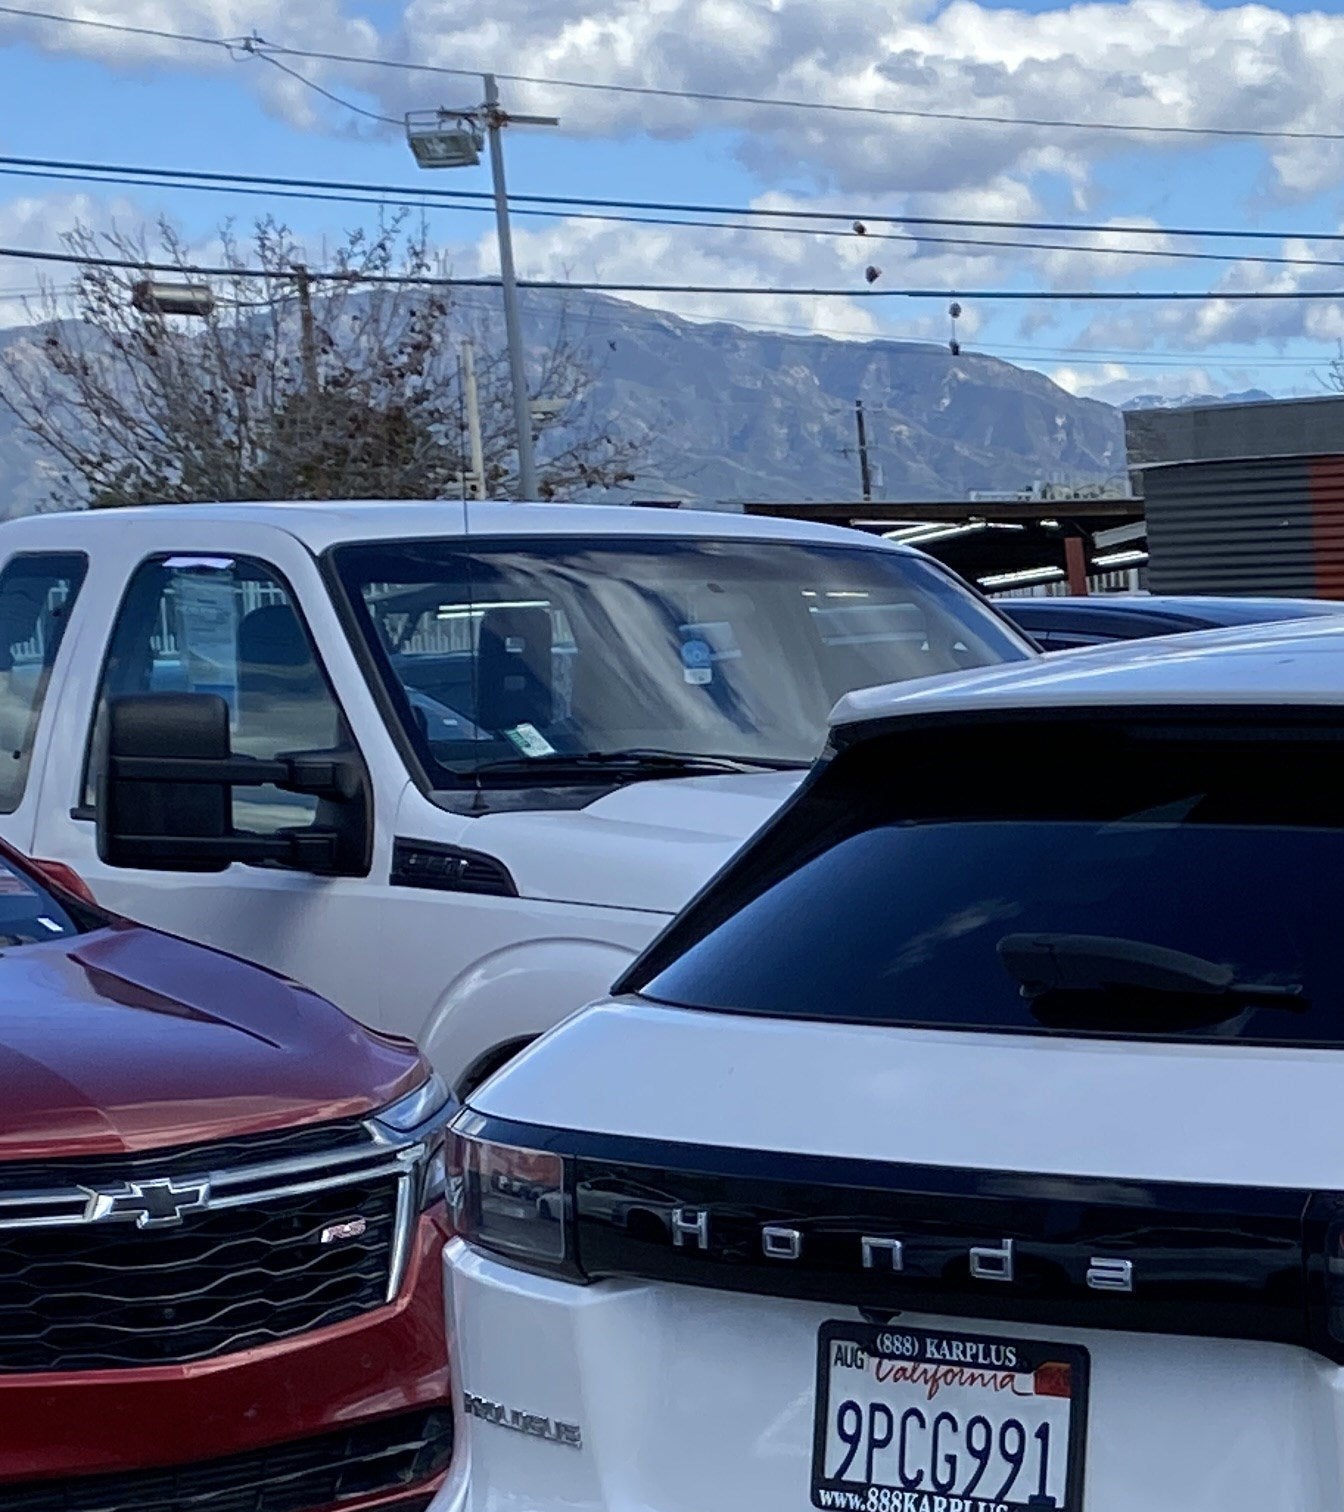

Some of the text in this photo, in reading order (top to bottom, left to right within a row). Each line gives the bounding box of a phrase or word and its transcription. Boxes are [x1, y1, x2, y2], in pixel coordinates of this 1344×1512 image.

[671, 1208, 1134, 1293] Honda
[834, 1344, 865, 1370] AUG
[876, 1333, 1017, 1367] (888) KARPLUS
[874, 1356, 1034, 1400] California
[834, 1399, 1057, 1507] 9PCG991
